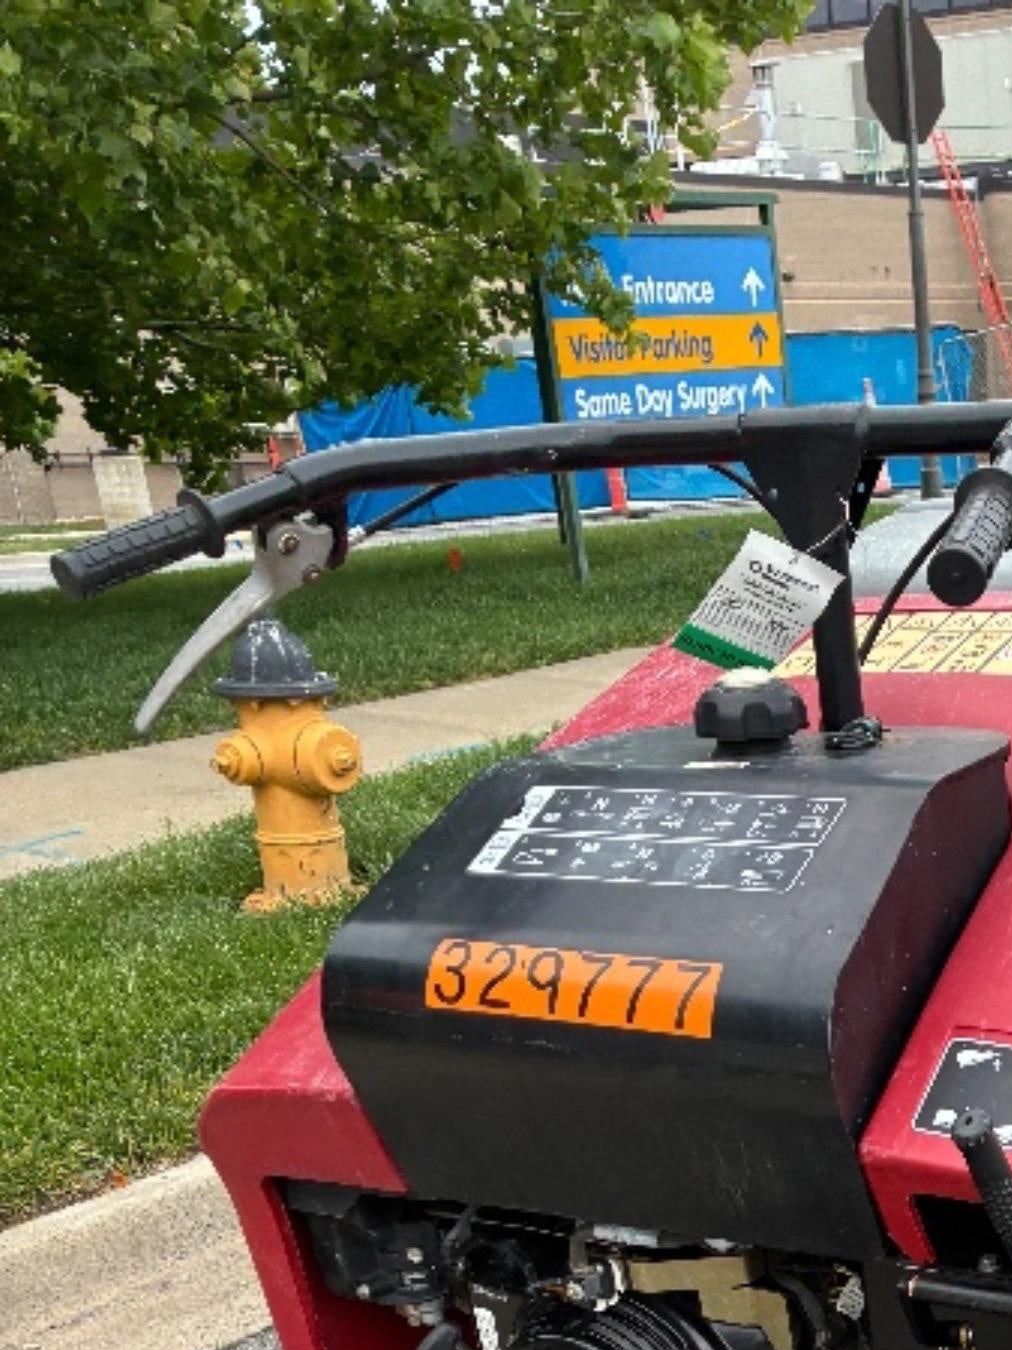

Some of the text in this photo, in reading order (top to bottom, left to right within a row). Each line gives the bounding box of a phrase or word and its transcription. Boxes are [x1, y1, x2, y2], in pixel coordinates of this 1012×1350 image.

[621, 273, 715, 305] Entrance
[566, 331, 636, 363] Visito
[574, 379, 748, 418] Same Day Surgery
[434, 941, 711, 1030] 329777
